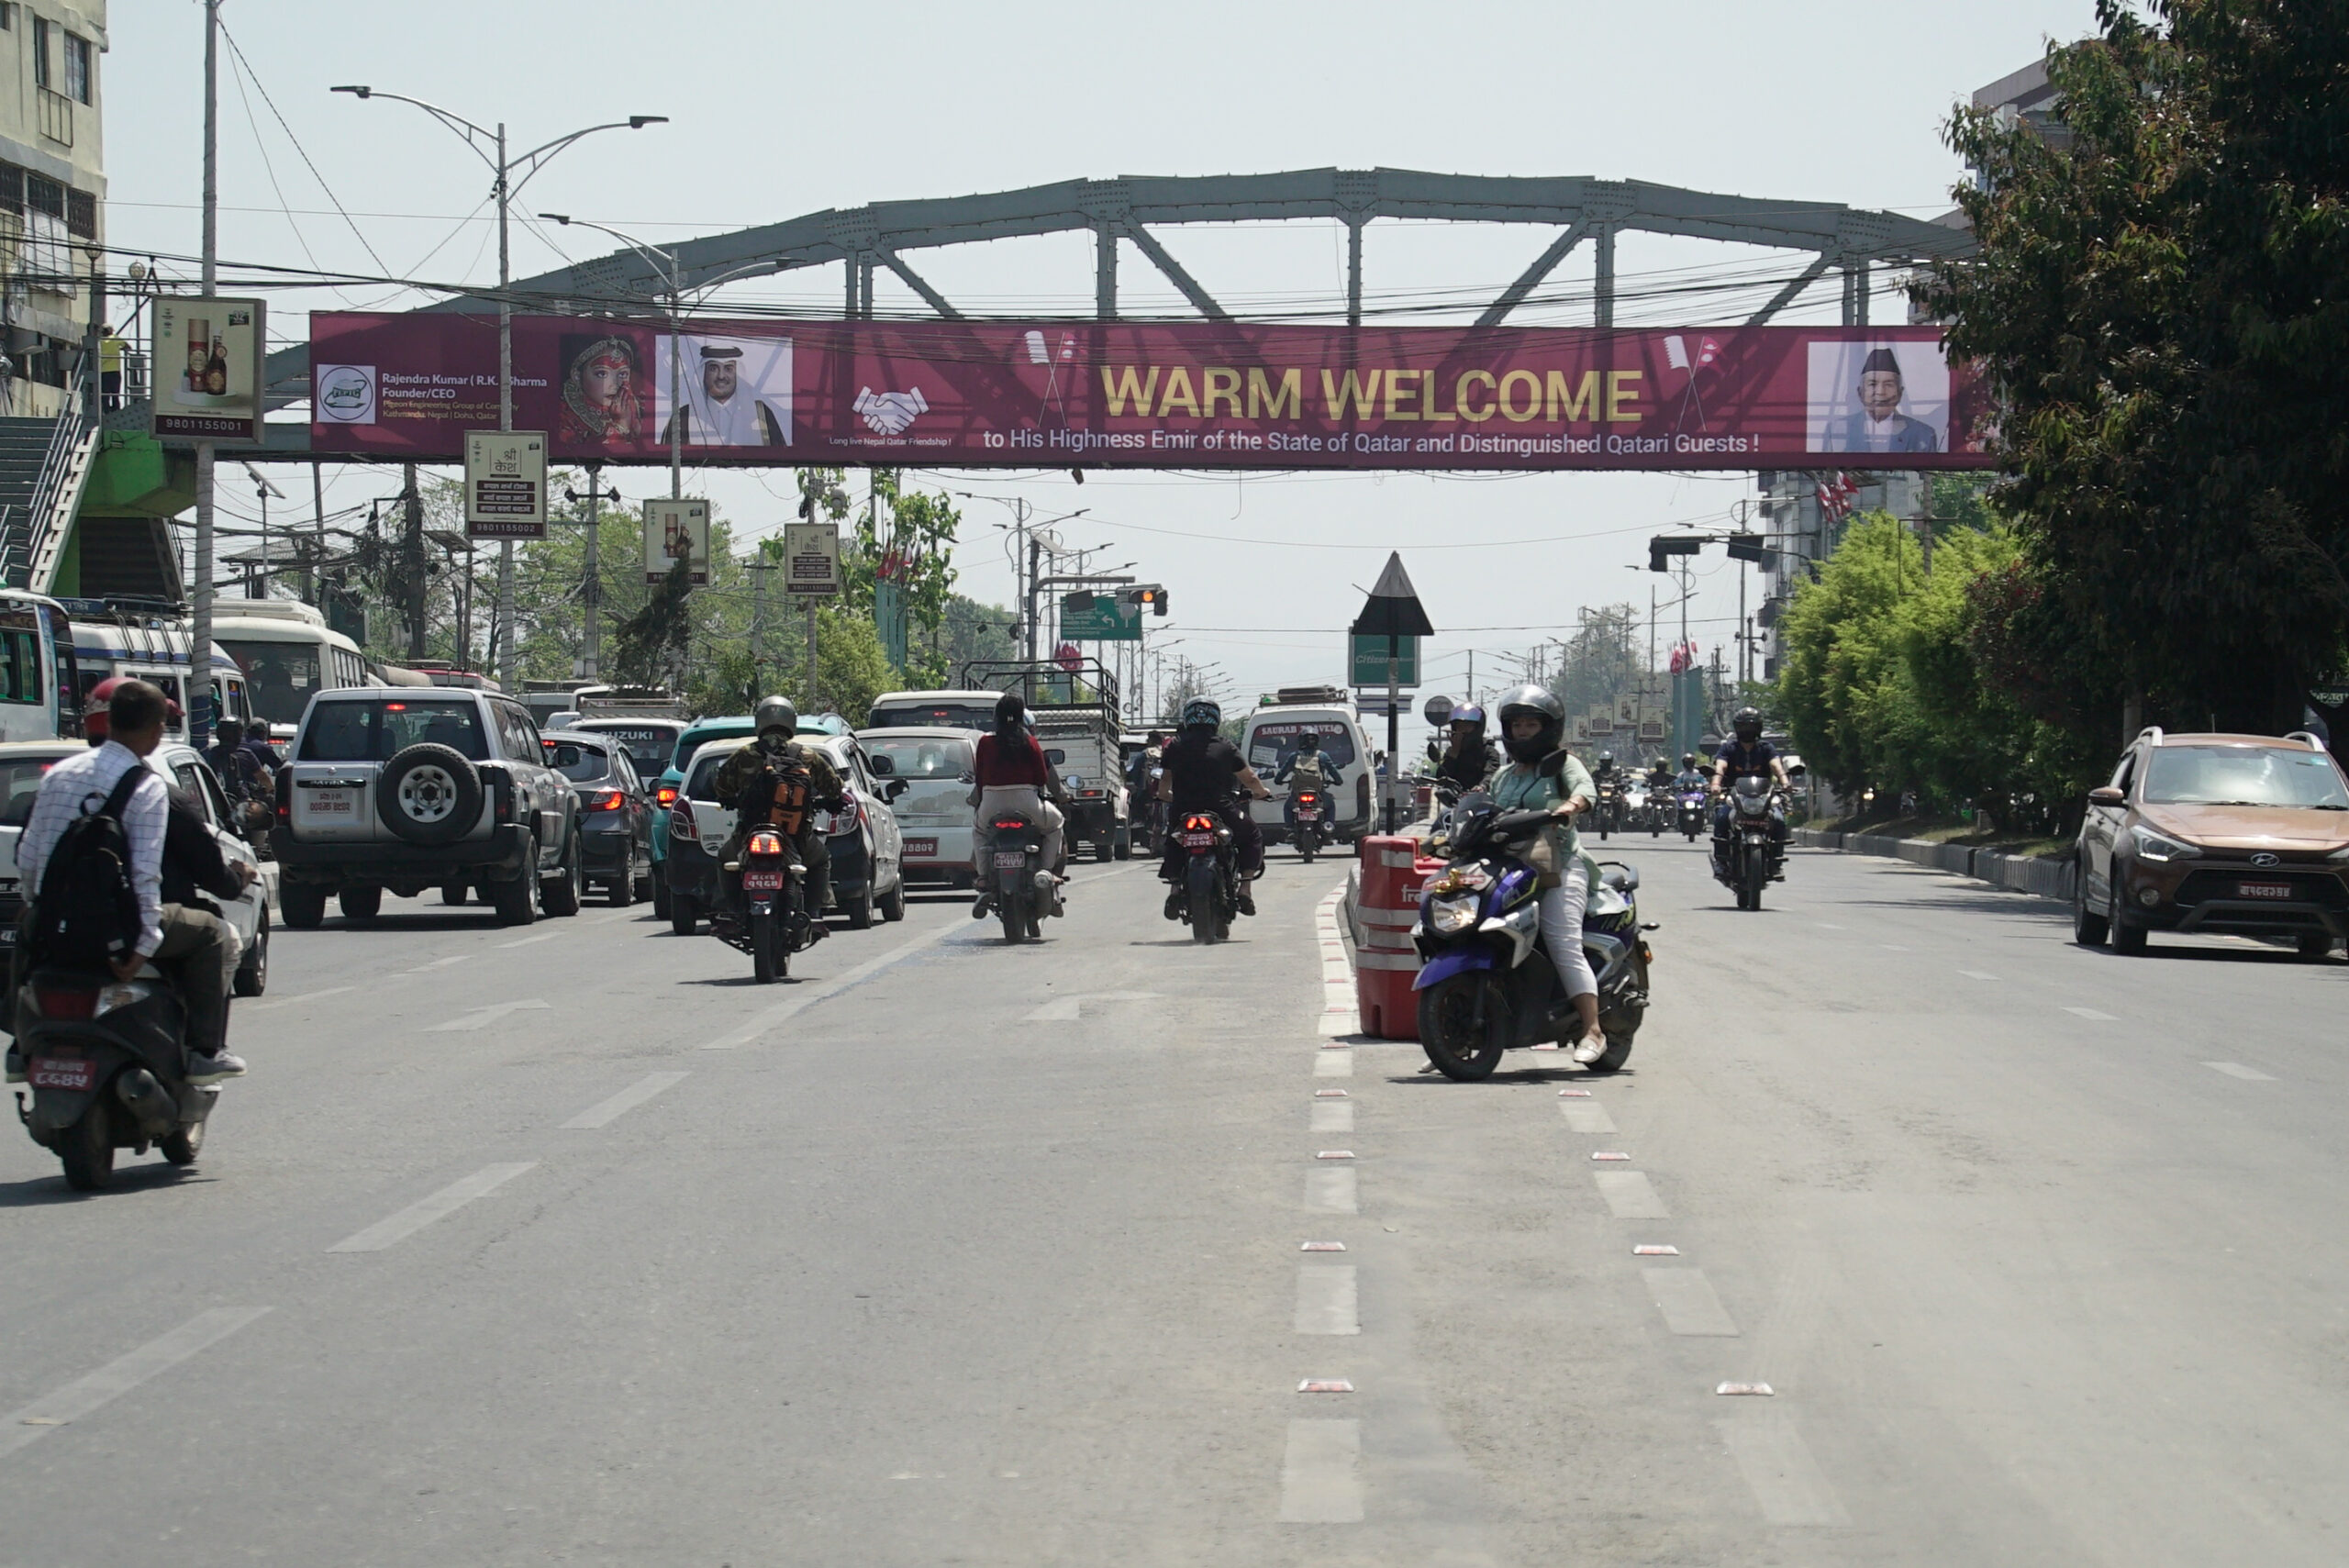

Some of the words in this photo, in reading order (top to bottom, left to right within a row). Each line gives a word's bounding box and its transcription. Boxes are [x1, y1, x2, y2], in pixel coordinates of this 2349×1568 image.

[382, 373, 430, 385] Rajendra
[432, 374, 469, 384] Kumar
[476, 375, 499, 385] R.K.
[382, 387, 456, 399] Founder/CEO
[1100, 366, 1301, 419] WARM
[1320, 369, 1642, 423] WELCOME
[409, 401, 451, 411] Engineering
[452, 402, 475, 411] Group
[476, 402, 484, 410] of
[166, 418, 241, 430] 9801155001
[829, 438, 848, 447] Long
[863, 438, 885, 447] Nepal
[908, 439, 946, 448] Friendship
[983, 430, 1004, 448] to
[1010, 429, 1043, 448] His
[1050, 429, 1145, 452] Highness
[1152, 430, 1197, 450] Emir
[1203, 430, 1224, 450] of
[1230, 431, 1262, 450] the
[1267, 431, 1323, 451] State
[1327, 432, 1349, 451] of
[1354, 432, 1411, 453] Qatar
[1416, 433, 1454, 453] and
[1460, 434, 1600, 458] Distinguished
[1607, 434, 1669, 455] Qatari
[1675, 434, 1747, 453] Guests
